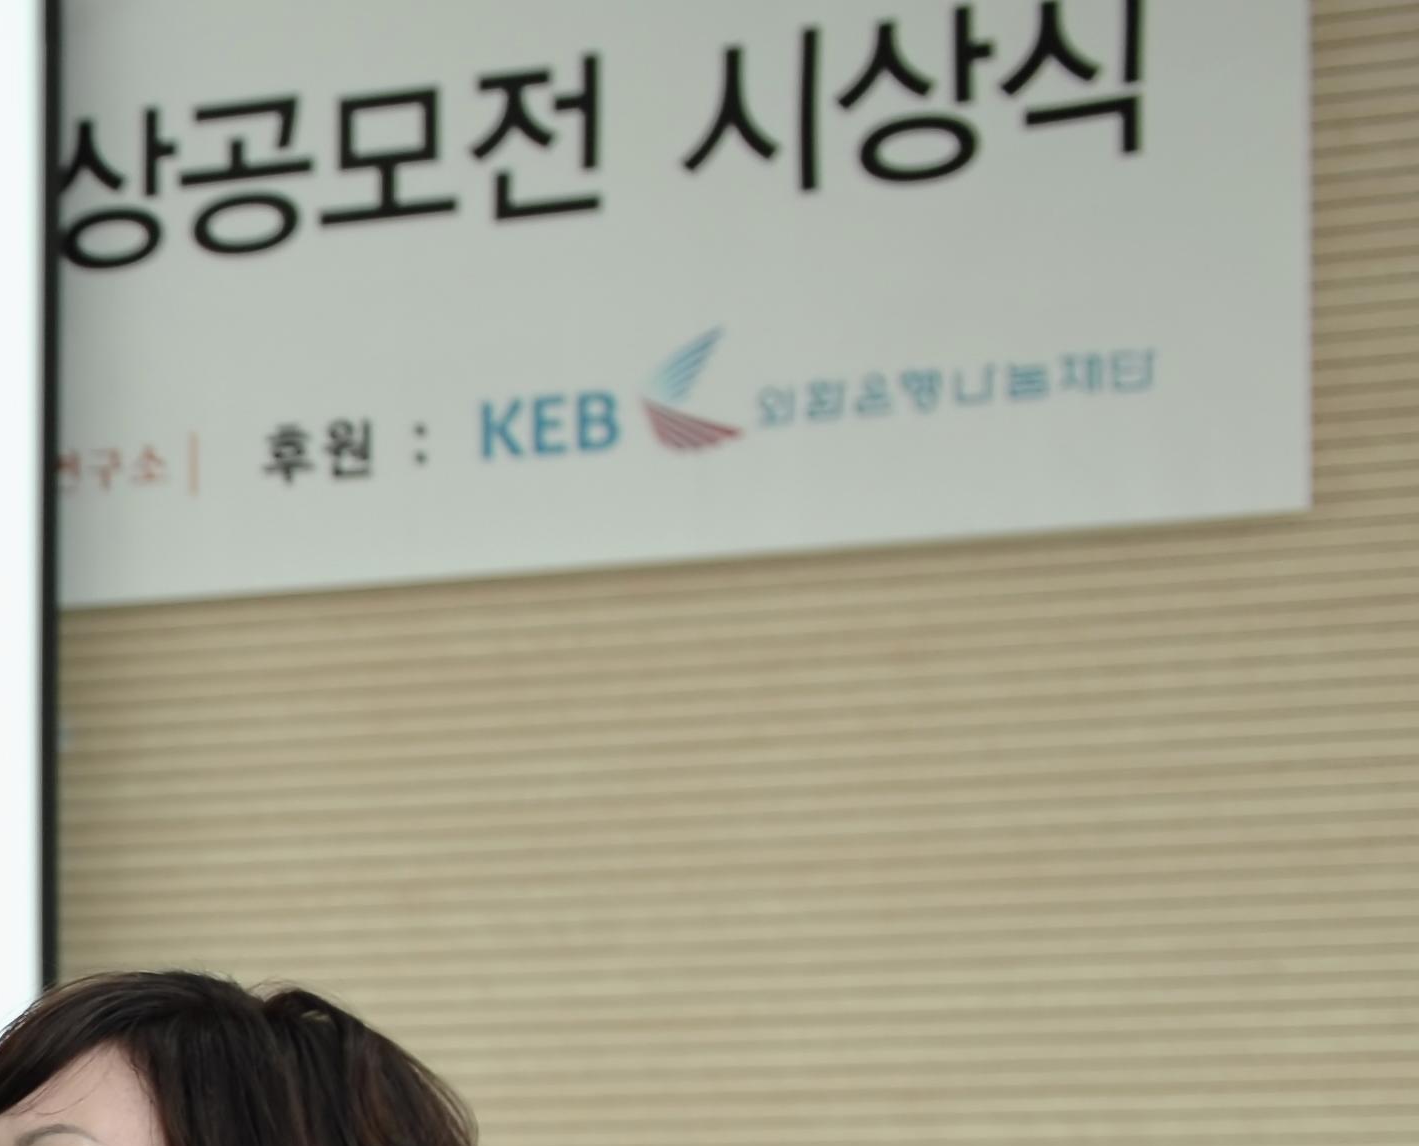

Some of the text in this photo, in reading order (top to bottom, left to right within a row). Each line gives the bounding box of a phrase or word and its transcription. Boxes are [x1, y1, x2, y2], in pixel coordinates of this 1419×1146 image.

[57, 0, 1145, 271] 상공모전 시상식
[263, 419, 373, 485] 후원
[479, 389, 620, 461] KEB
